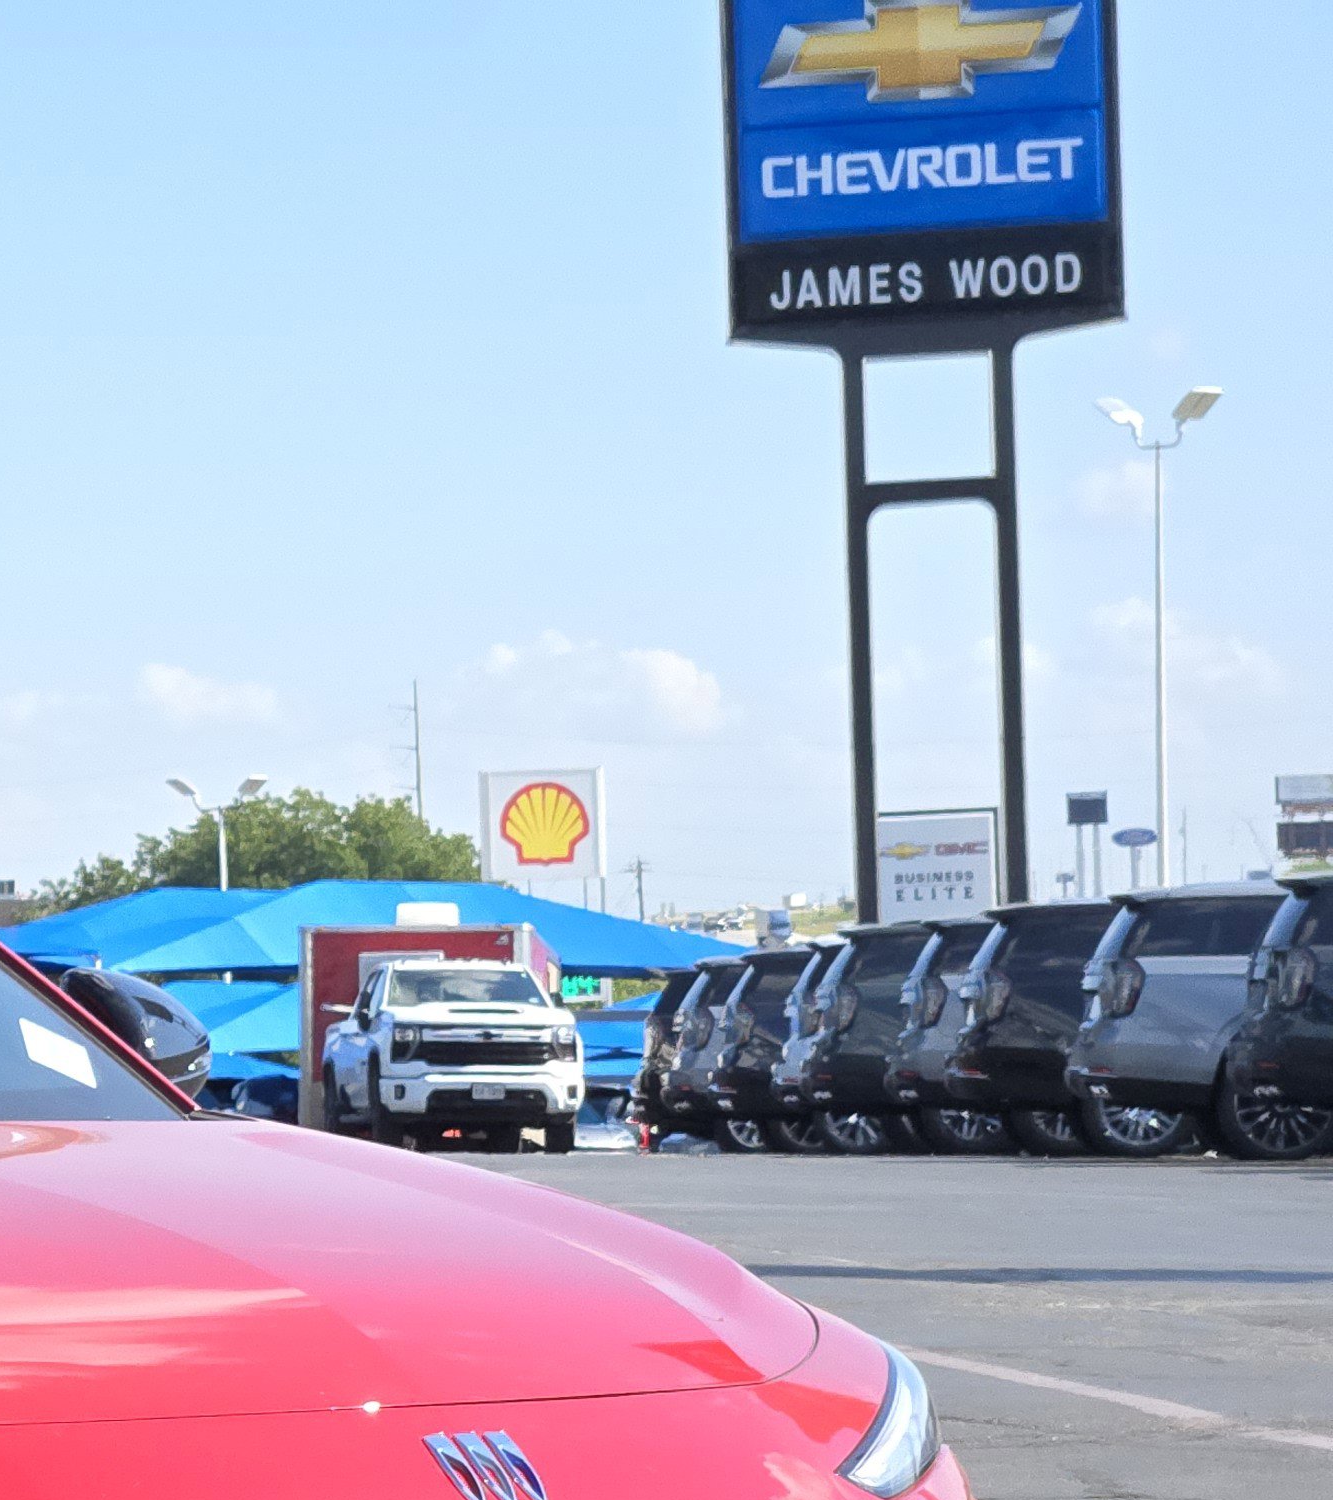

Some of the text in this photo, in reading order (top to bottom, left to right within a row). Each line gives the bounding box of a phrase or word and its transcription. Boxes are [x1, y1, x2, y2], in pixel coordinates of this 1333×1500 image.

[761, 137, 1084, 199] CHEVROLET
[769, 252, 1082, 310] JAMES WOOD
[893, 870, 974, 884] BUSINESS
[895, 886, 974, 902] ELITE
